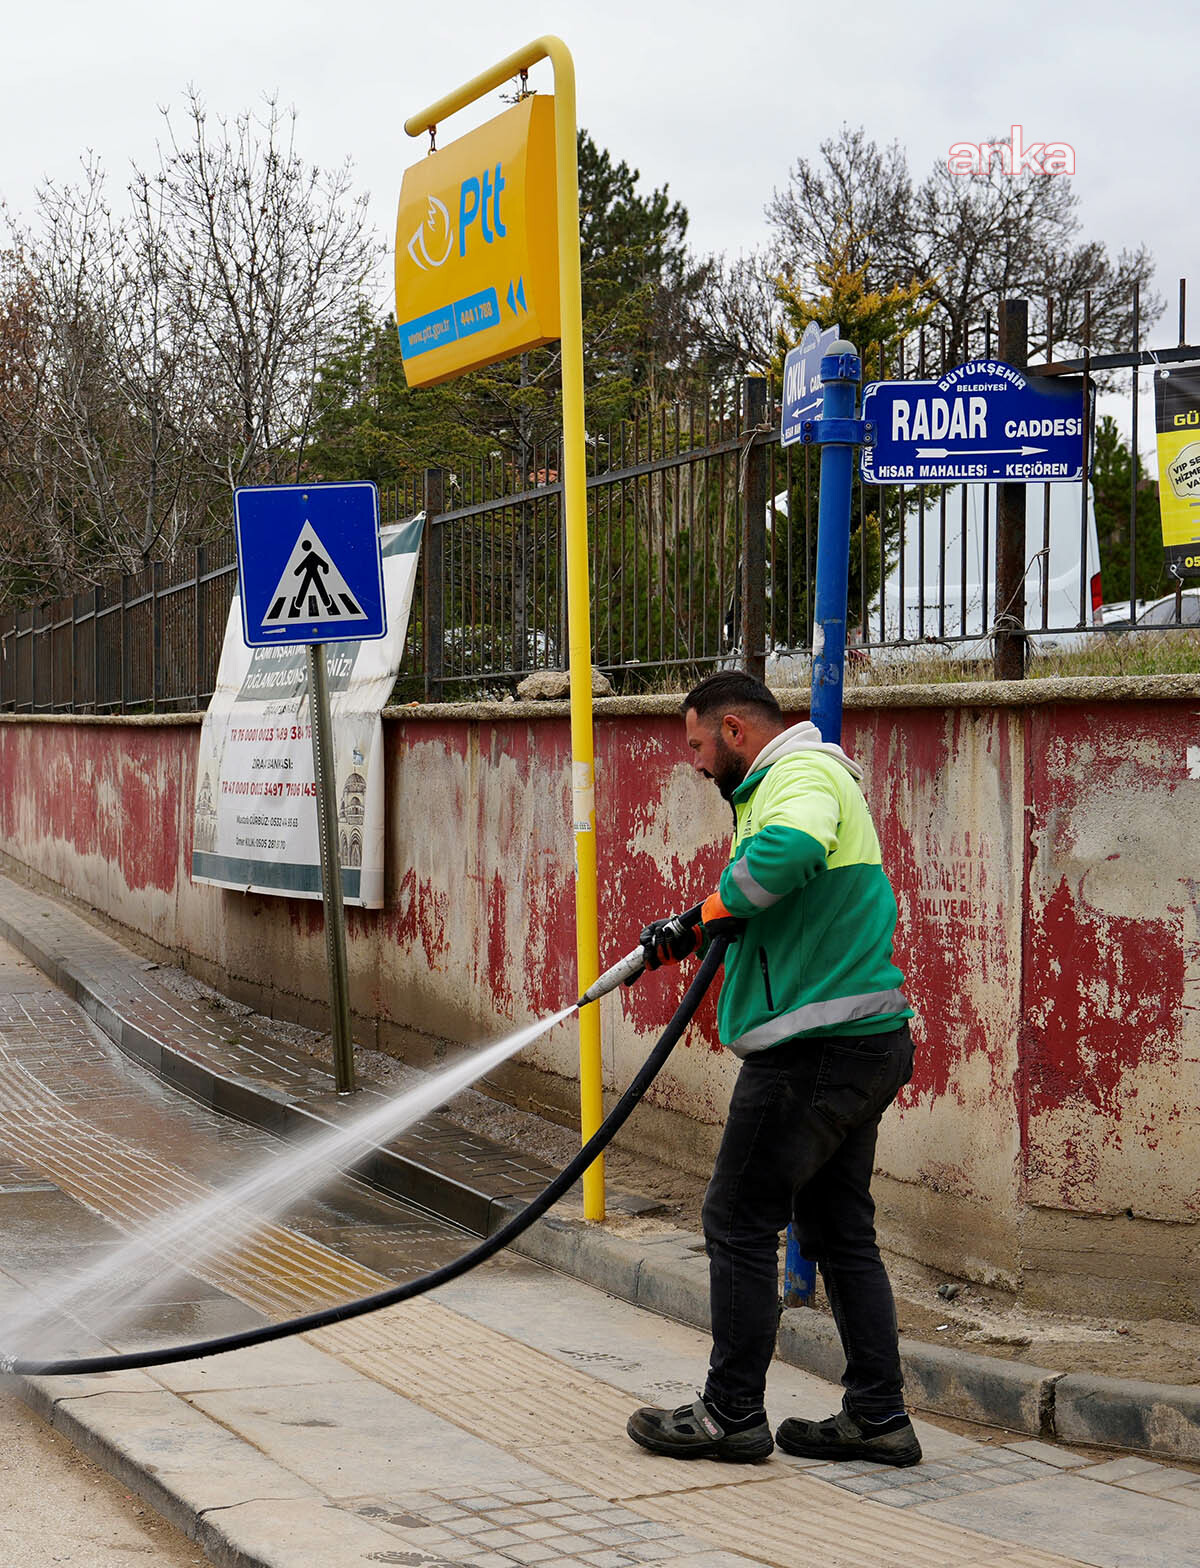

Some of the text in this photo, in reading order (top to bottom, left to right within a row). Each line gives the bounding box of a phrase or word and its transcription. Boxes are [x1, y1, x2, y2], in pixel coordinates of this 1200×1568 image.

[459, 161, 506, 257] Ptt
[460, 308, 475, 325] 444
[407, 319, 450, 345] www.ptt.gov.tr
[786, 358, 807, 406] OKUL
[938, 361, 1027, 392] BÜYÜKŞEHİR
[956, 382, 1007, 392] BELEDİYESİ
[891, 396, 988, 441] RADAR
[1173, 462, 1187, 474] VIP
